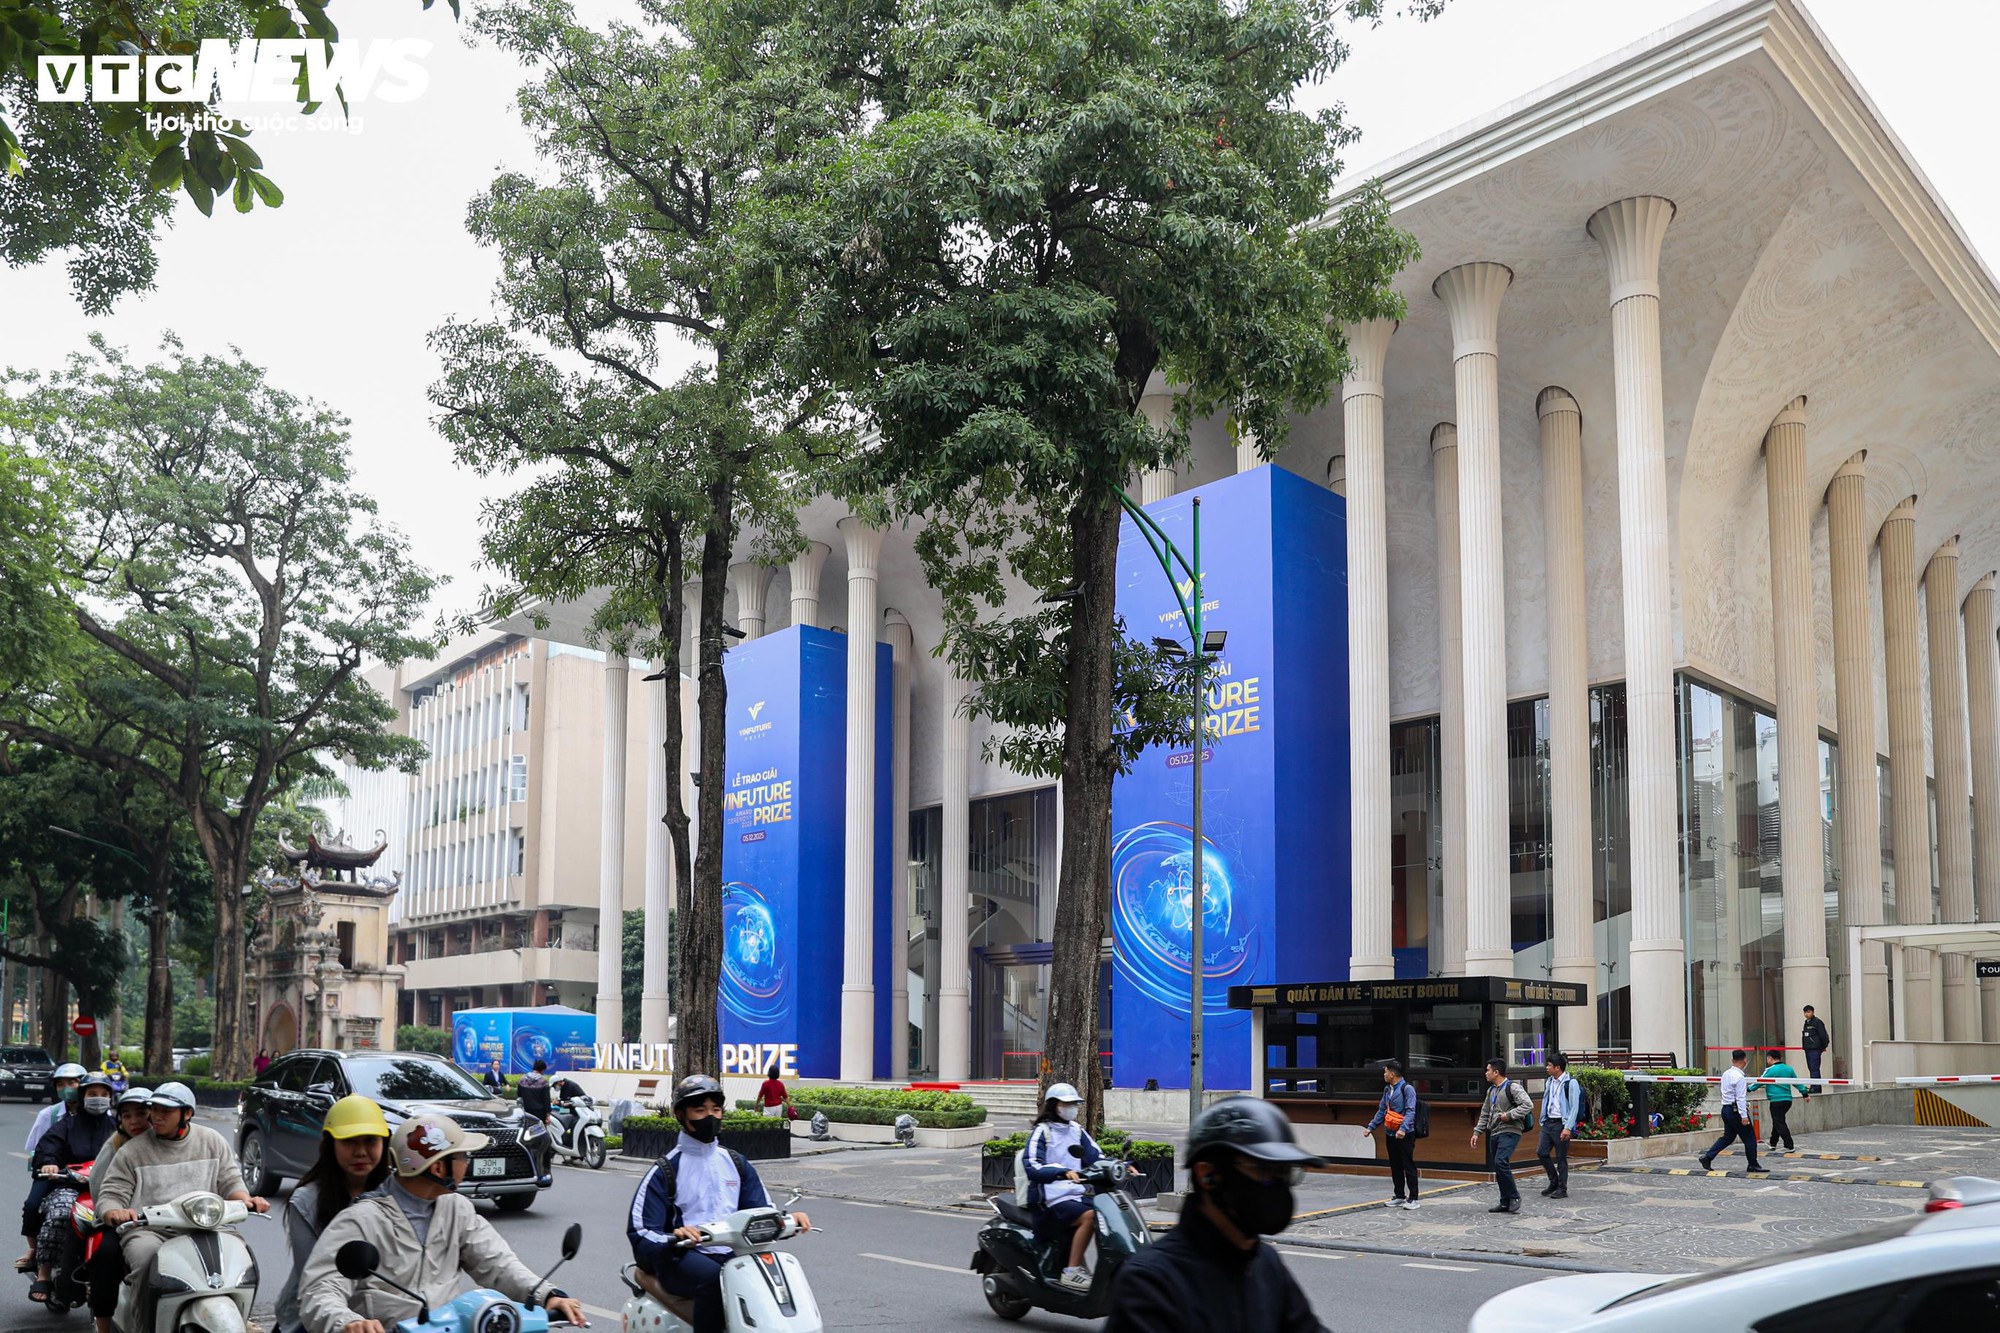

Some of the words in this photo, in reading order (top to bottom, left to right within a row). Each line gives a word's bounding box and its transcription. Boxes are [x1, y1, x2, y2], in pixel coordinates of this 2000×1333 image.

[1169, 751, 1210, 766] 05.12.225
[742, 772, 761, 785] TRAO
[753, 801, 792, 827] PRIZE
[1320, 985, 1344, 1001] BÁN
[1373, 985, 1414, 999] TICKET
[1417, 983, 1459, 998] BOOTH
[593, 1043, 674, 1072] VINFUT
[722, 1043, 798, 1076] PRIZE
